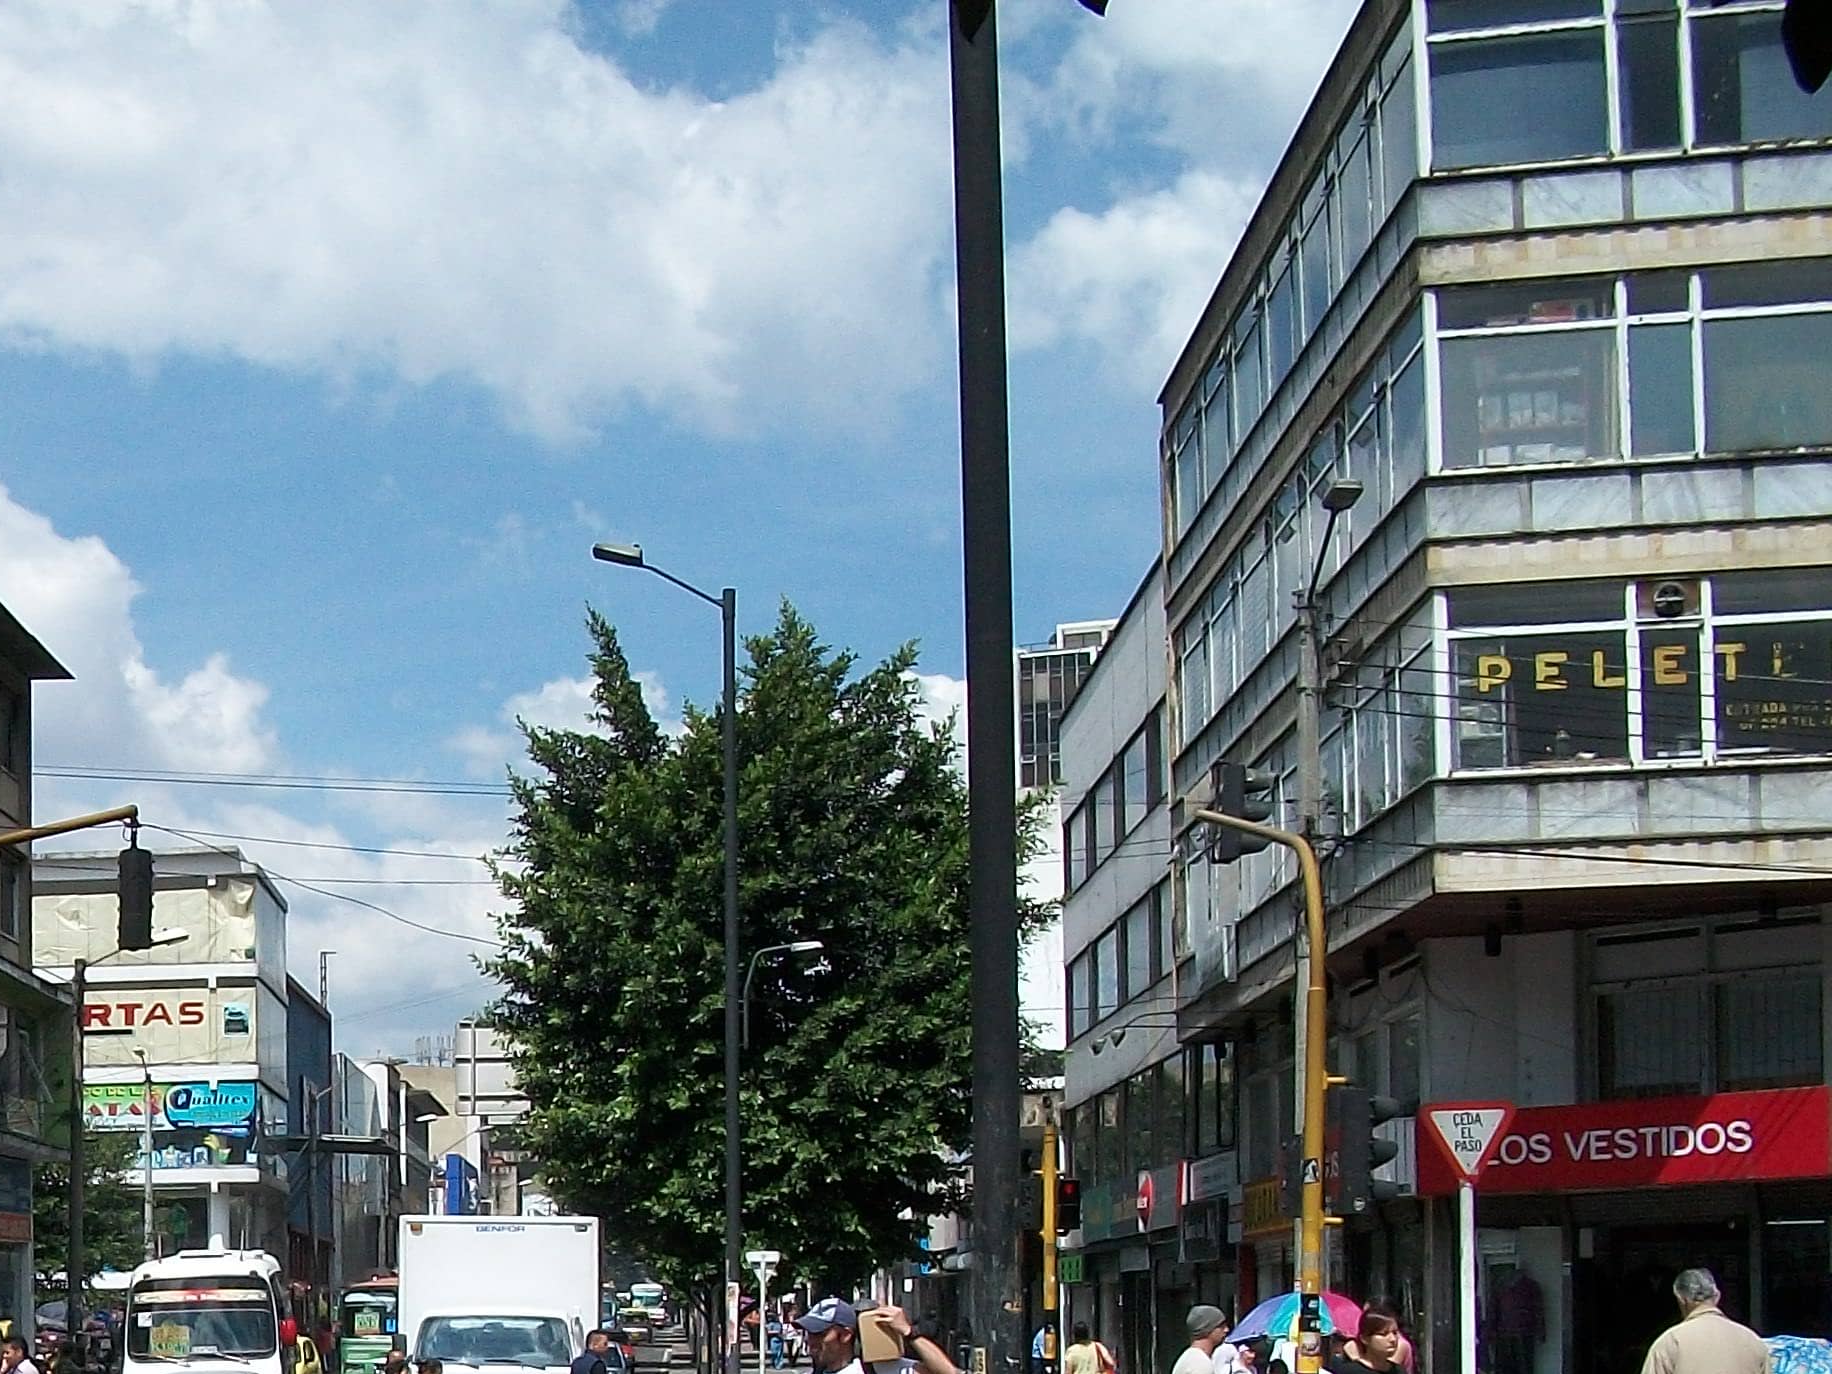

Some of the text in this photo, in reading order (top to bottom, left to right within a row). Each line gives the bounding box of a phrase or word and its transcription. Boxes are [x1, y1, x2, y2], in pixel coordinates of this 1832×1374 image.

[1452, 1112, 1483, 1128] CEDA
[1460, 1127, 1474, 1139] EL
[1454, 1140, 1482, 1152] PASO
[1486, 1120, 1754, 1166] OS VESTIDOS
